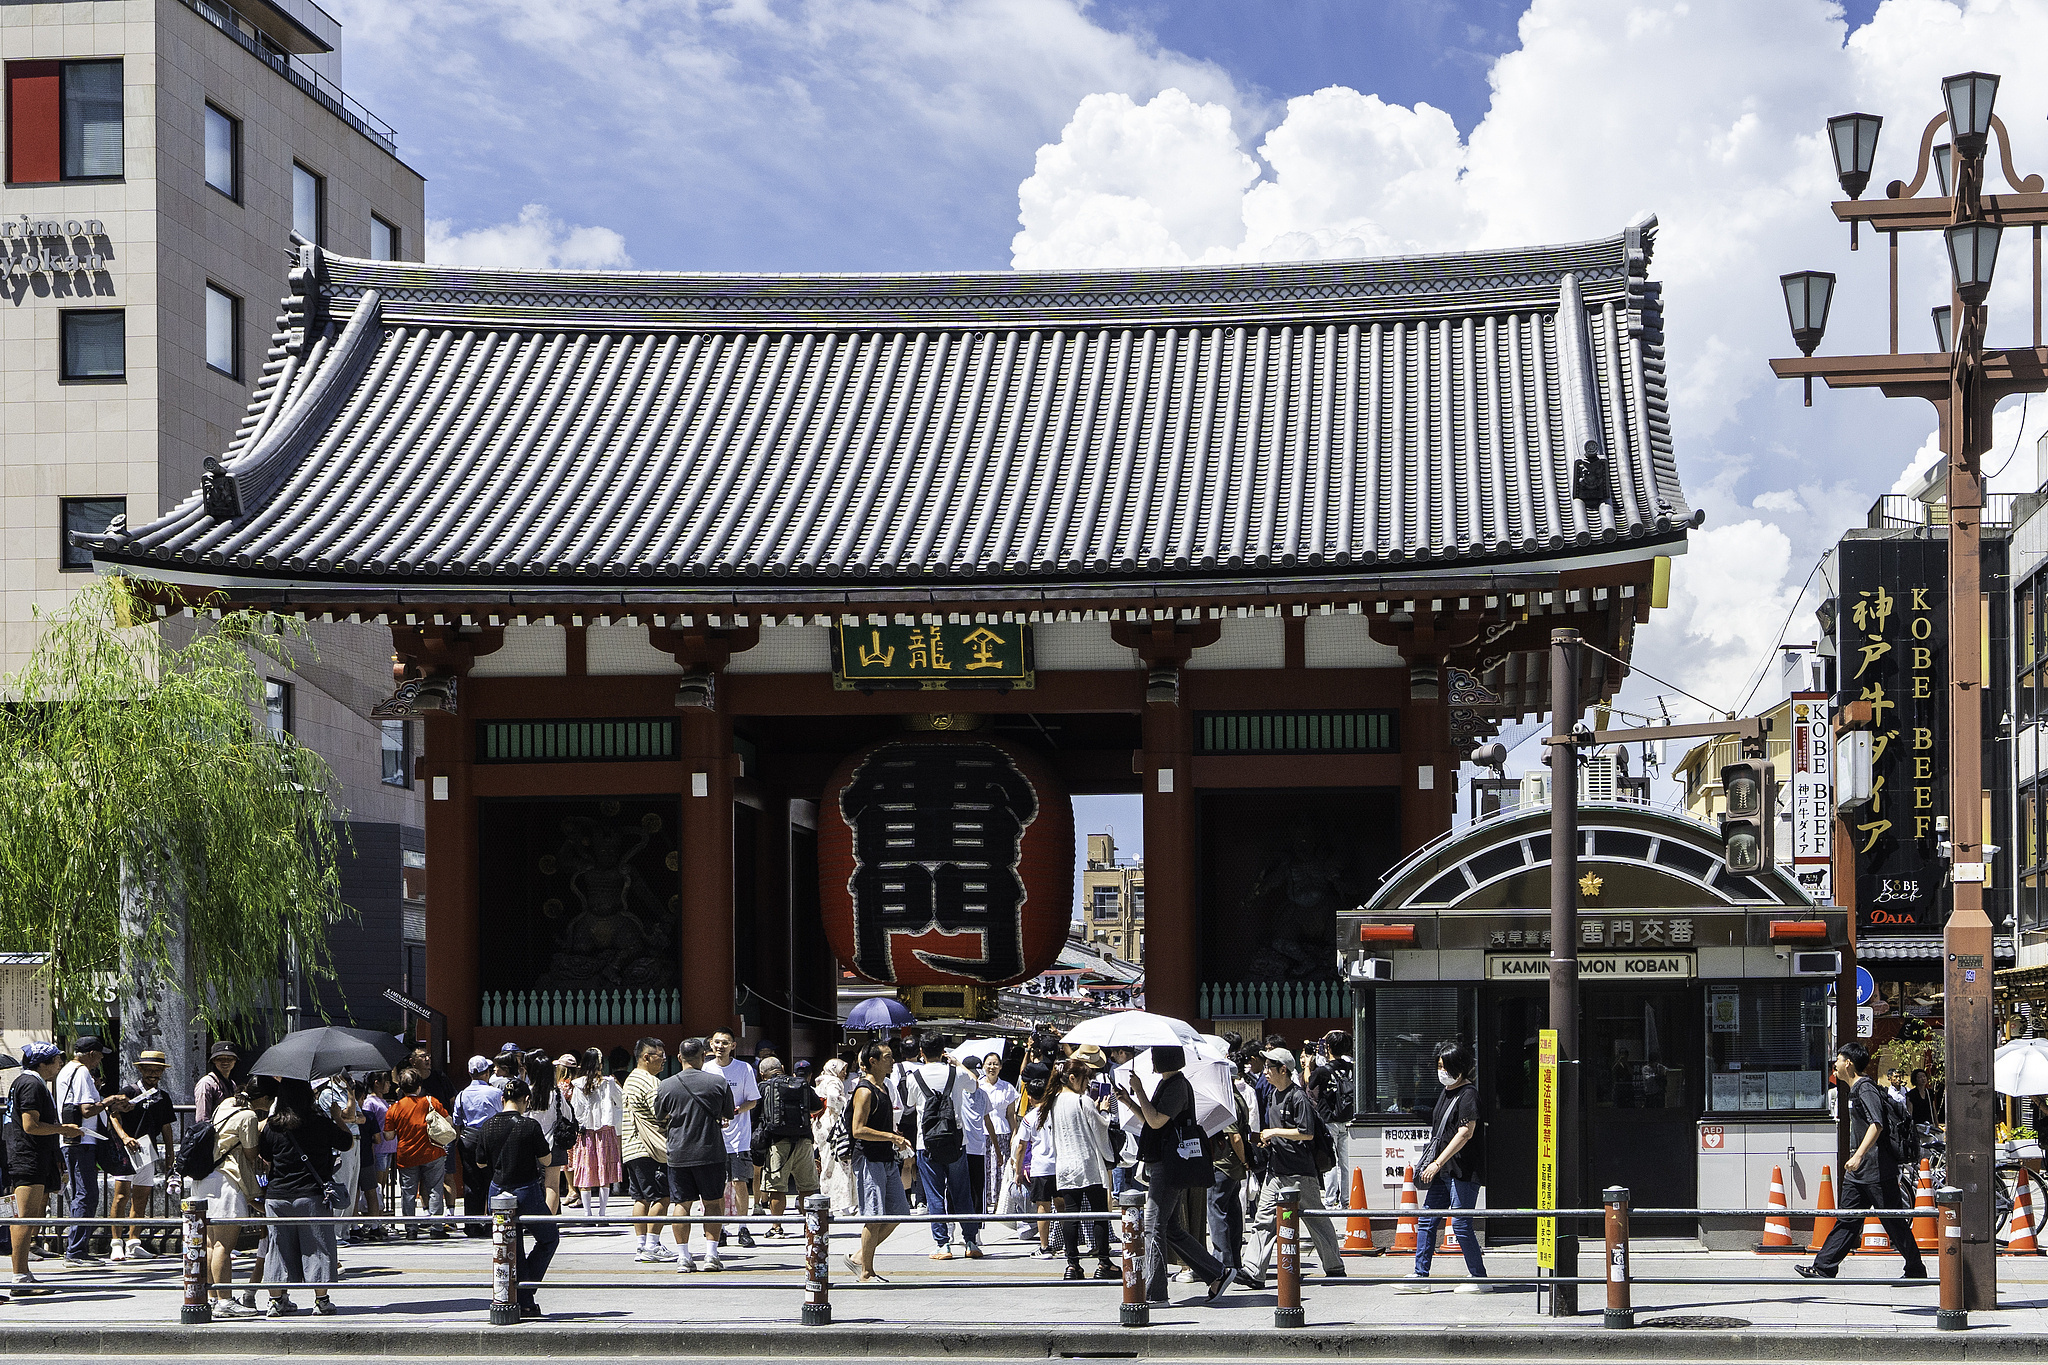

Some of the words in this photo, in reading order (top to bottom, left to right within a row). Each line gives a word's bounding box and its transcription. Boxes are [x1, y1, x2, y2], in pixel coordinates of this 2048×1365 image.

[1911, 588, 1932, 699] KOBE
[1812, 704, 1827, 774] KOBE
[1912, 727, 1933, 838] BEEF
[1797, 783, 1810, 854] 神戸牛ダイア
[1813, 783, 1828, 854] BEEF
[839, 741, 1039, 983] 雷門
[1490, 929, 1552, 945] 浅草警察
[1580, 918, 1694, 944] 雷門交番
[1870, 909, 1916, 924] DAIA
[1502, 959, 1616, 974] KAMINMON
[1625, 959, 1679, 973] KOBAN
[1385, 1147, 1405, 1158] 死亡
